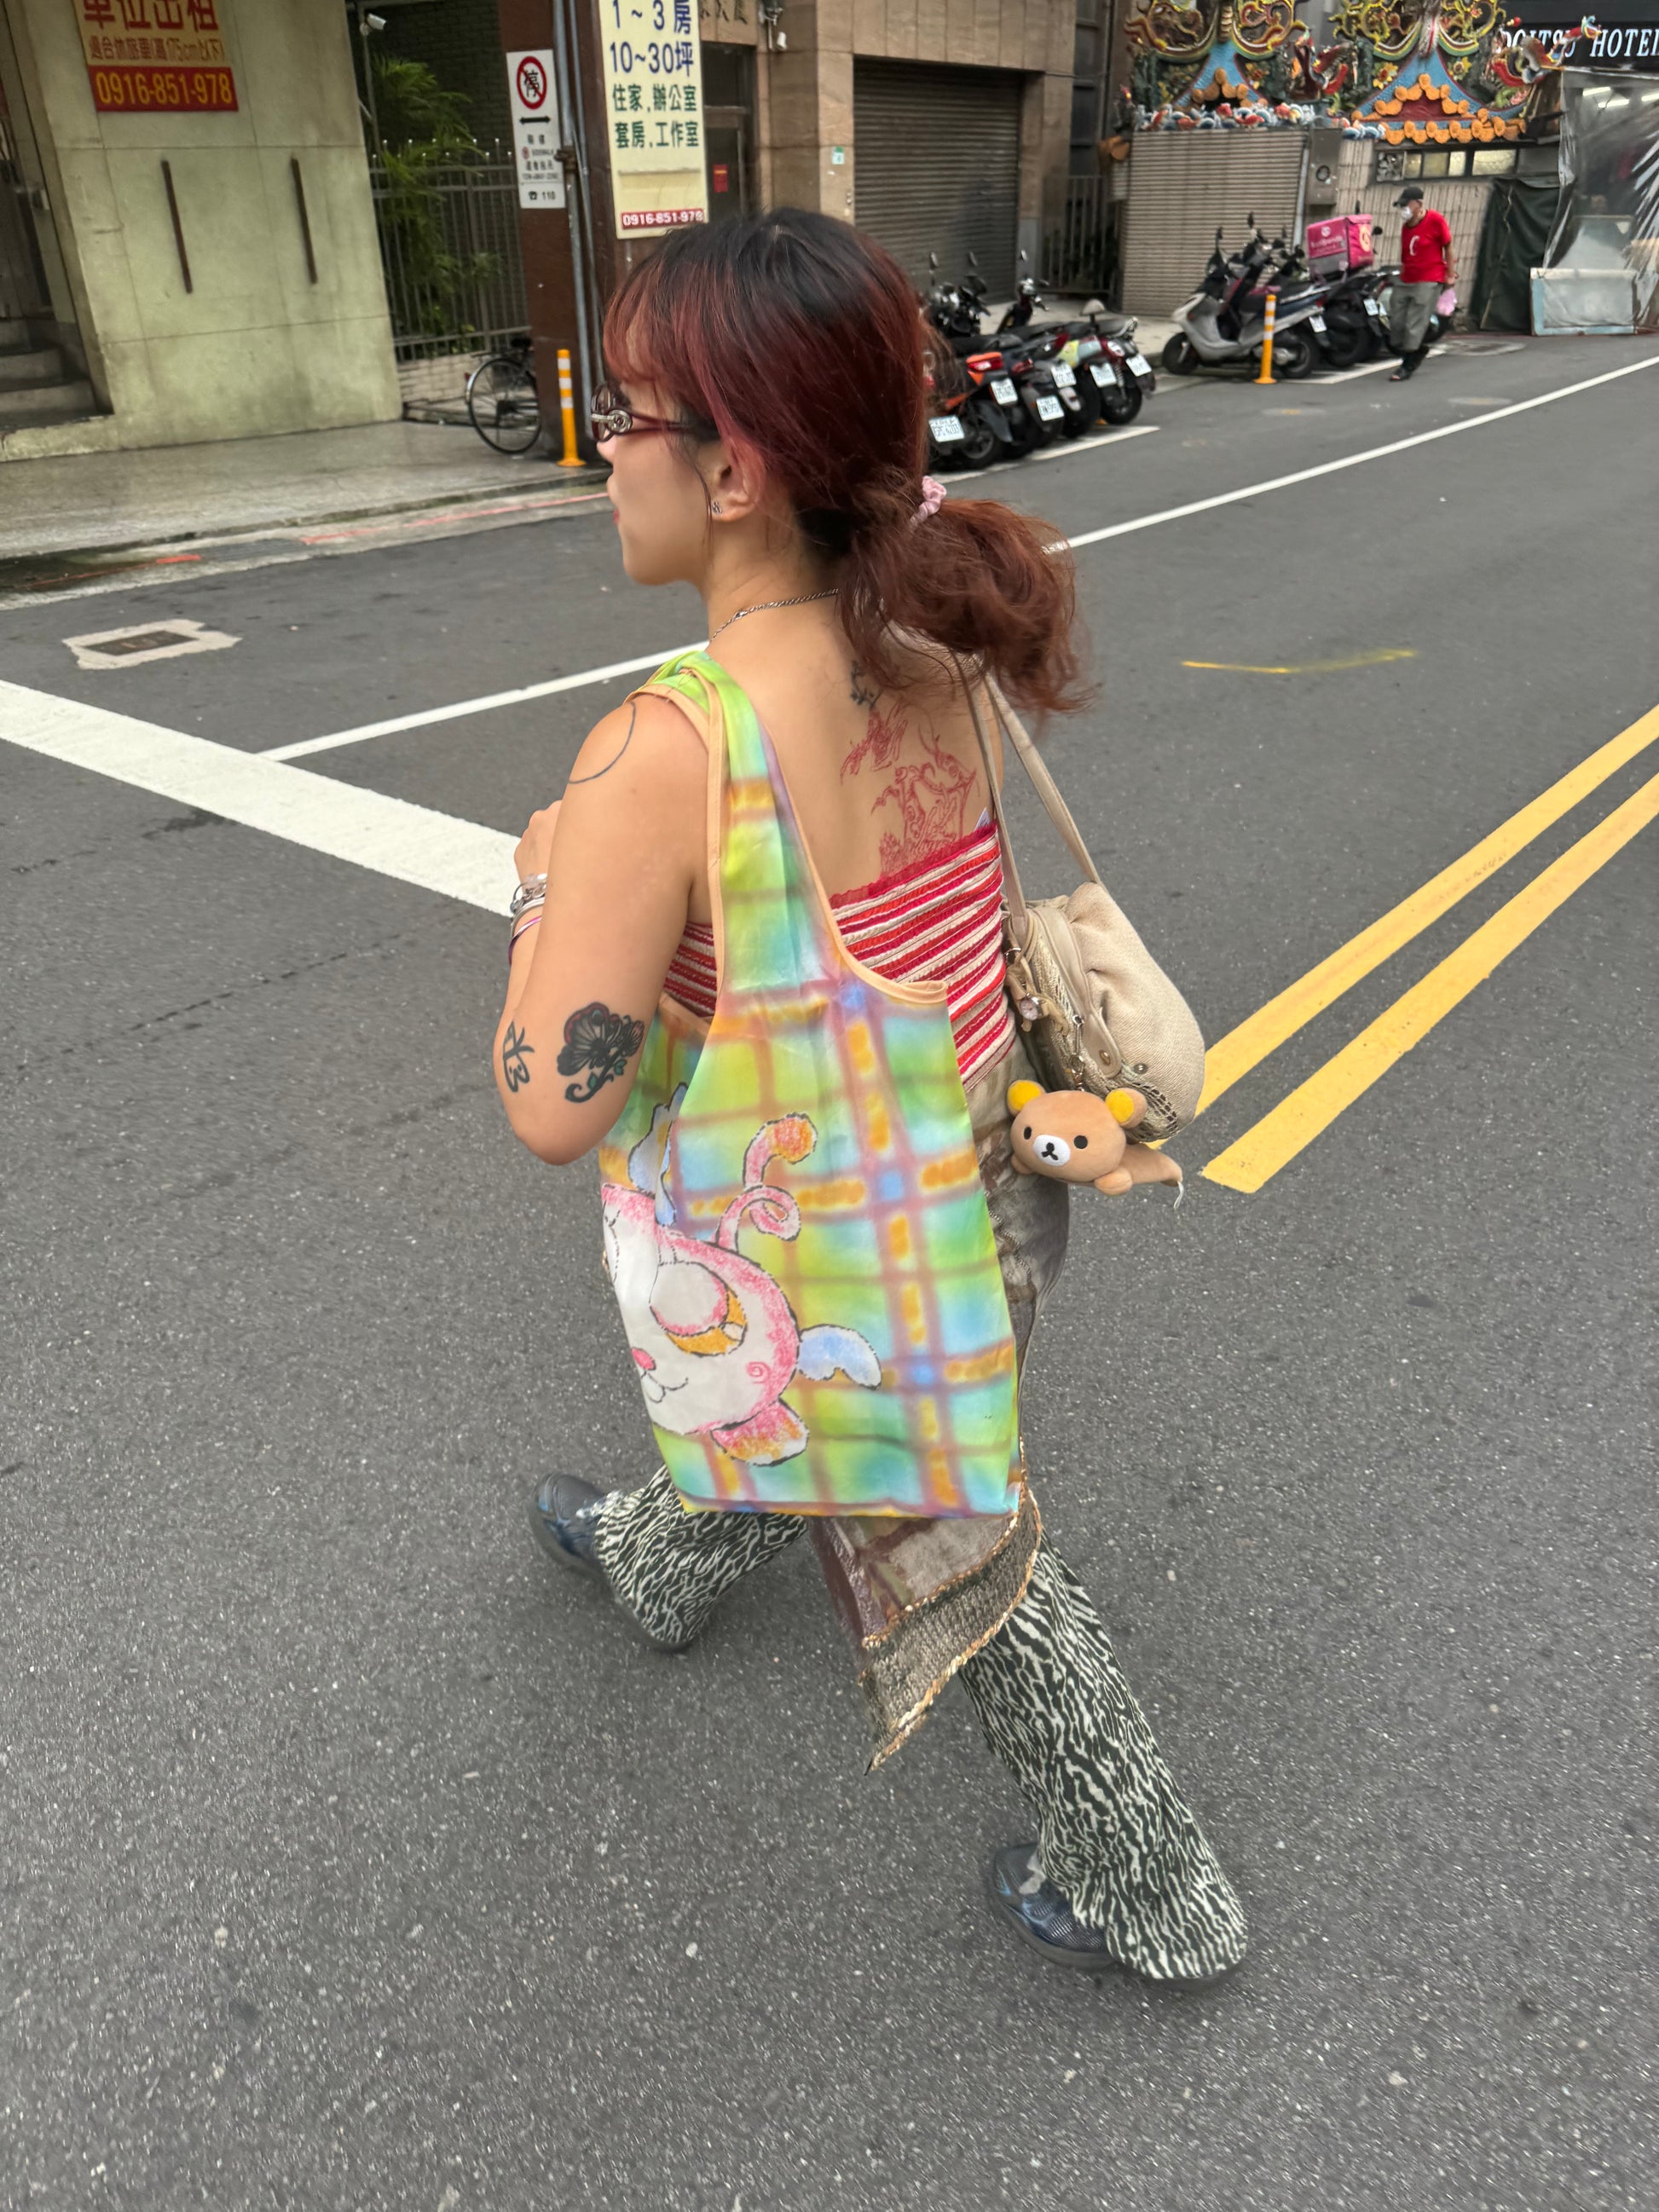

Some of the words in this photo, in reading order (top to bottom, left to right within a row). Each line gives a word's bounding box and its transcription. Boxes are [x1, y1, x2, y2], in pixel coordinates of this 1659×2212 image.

[609, 41, 693, 77] 10~30坪
[95, 72, 232, 104] 0916-851-978
[622, 211, 703, 226] 0916-851-978
